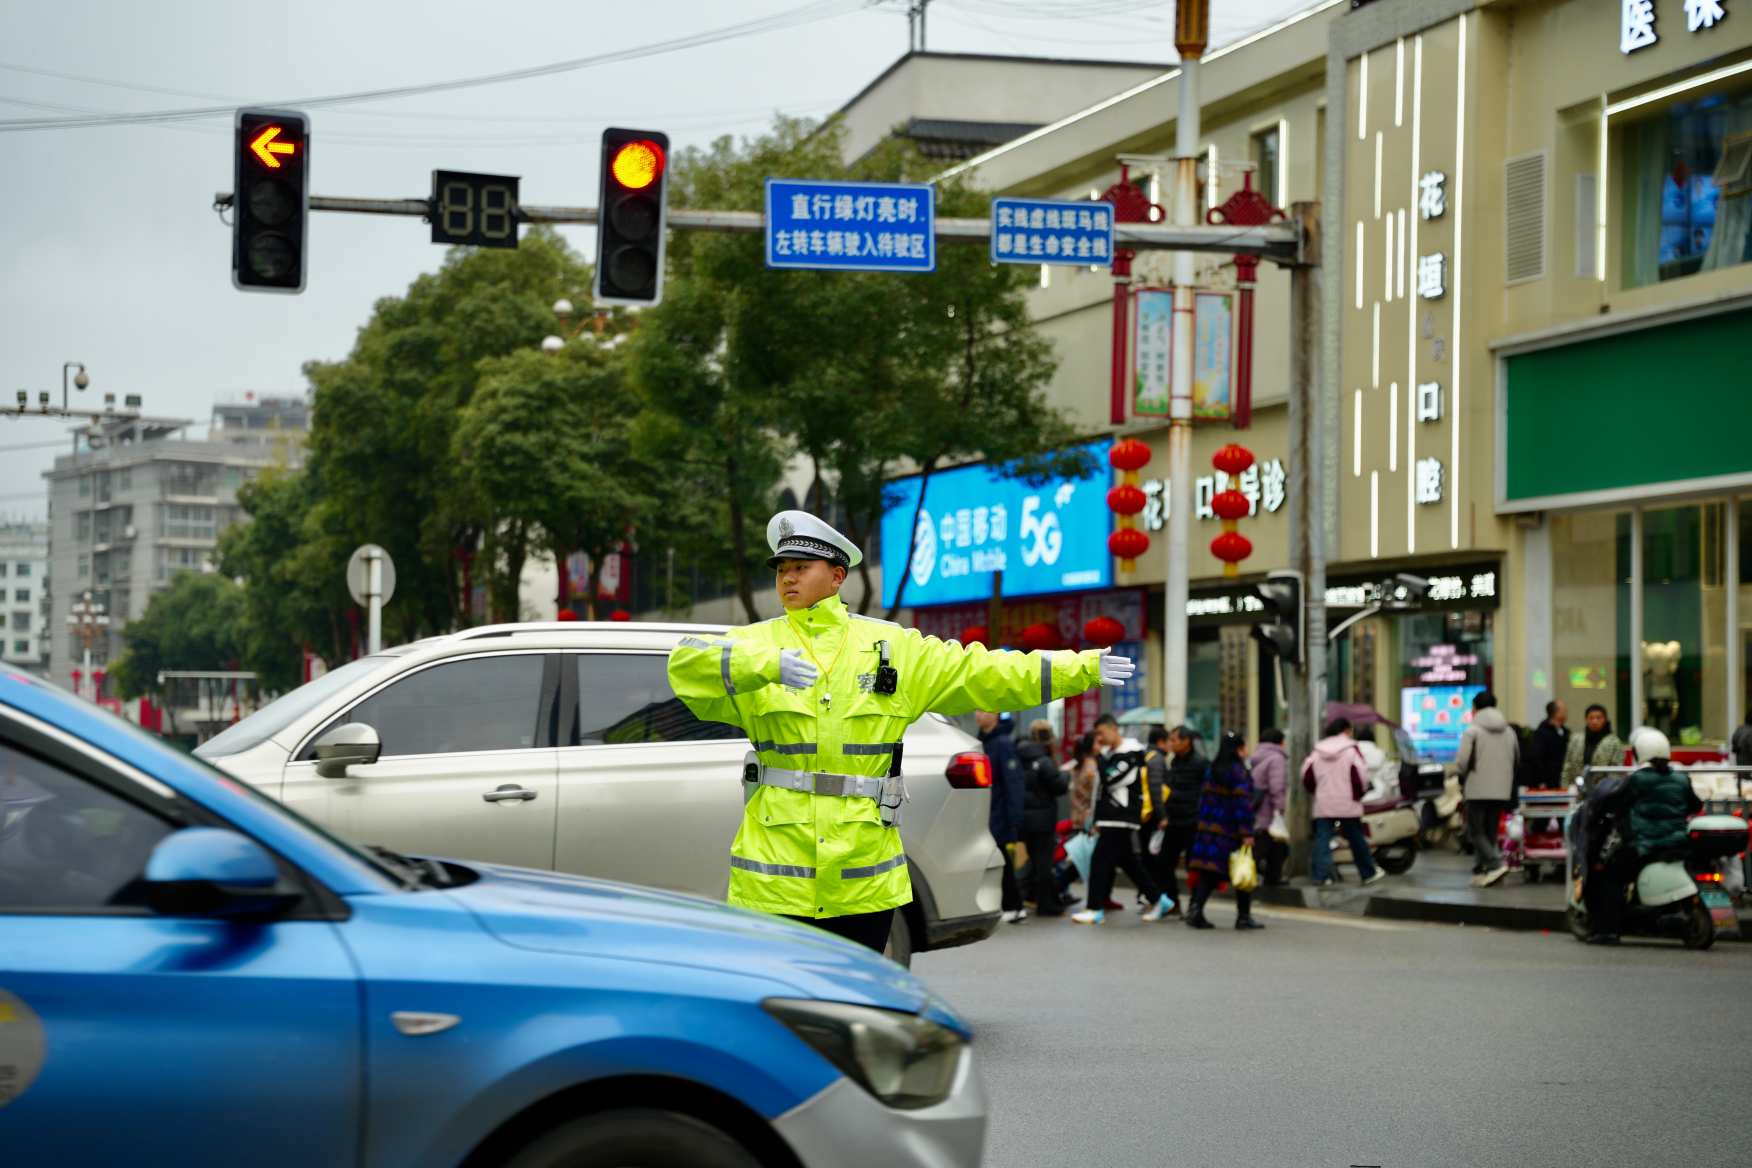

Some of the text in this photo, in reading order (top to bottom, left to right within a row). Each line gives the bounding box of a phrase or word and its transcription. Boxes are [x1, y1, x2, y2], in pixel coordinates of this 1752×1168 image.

[940, 504, 1007, 548] 中国移动
[1020, 496, 1062, 567] 5G
[940, 547, 1007, 578] China Mobile
